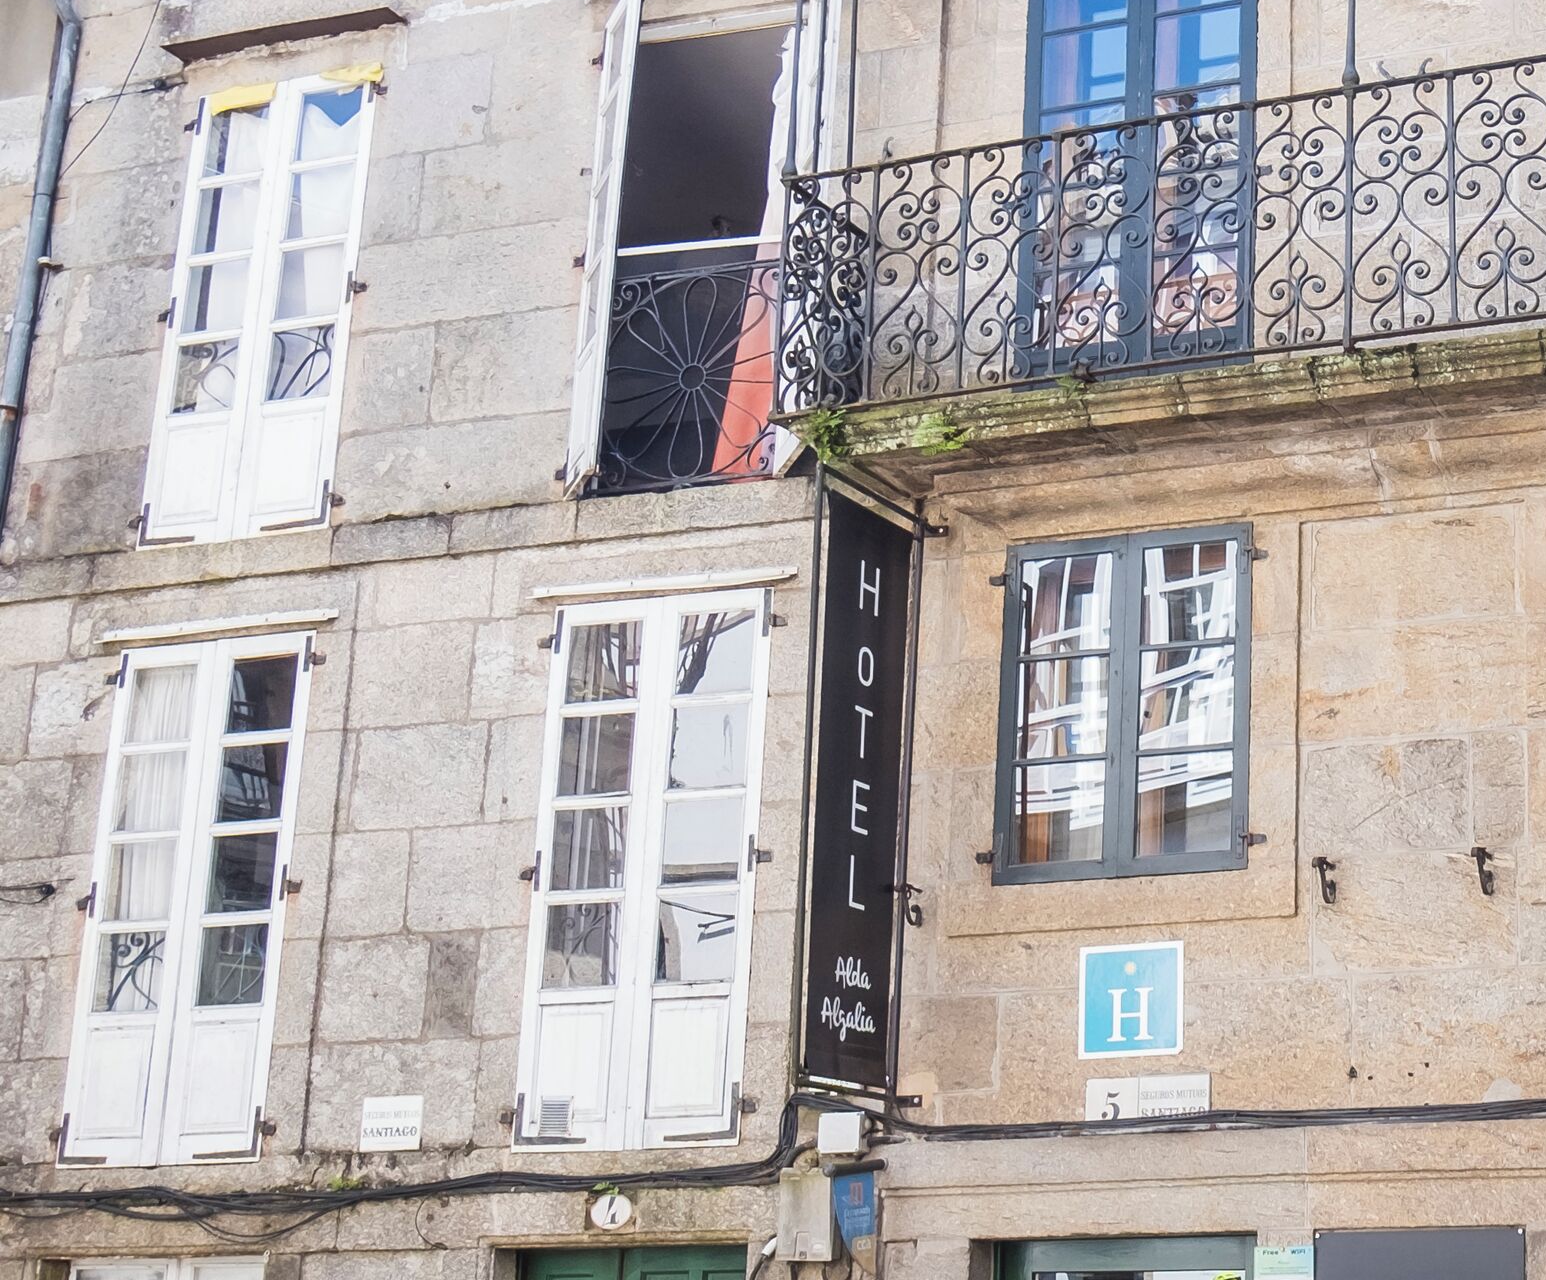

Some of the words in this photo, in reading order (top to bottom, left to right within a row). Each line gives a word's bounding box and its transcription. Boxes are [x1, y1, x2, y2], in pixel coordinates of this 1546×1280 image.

[847, 558, 882, 913] HOTEL
[834, 954, 873, 993] Alda
[820, 994, 877, 1043] Algalia
[1106, 986, 1154, 1043] H
[1101, 1091, 1121, 1120] 5
[362, 1126, 418, 1138] SANTIAGO
[603, 1196, 618, 1226] 4
